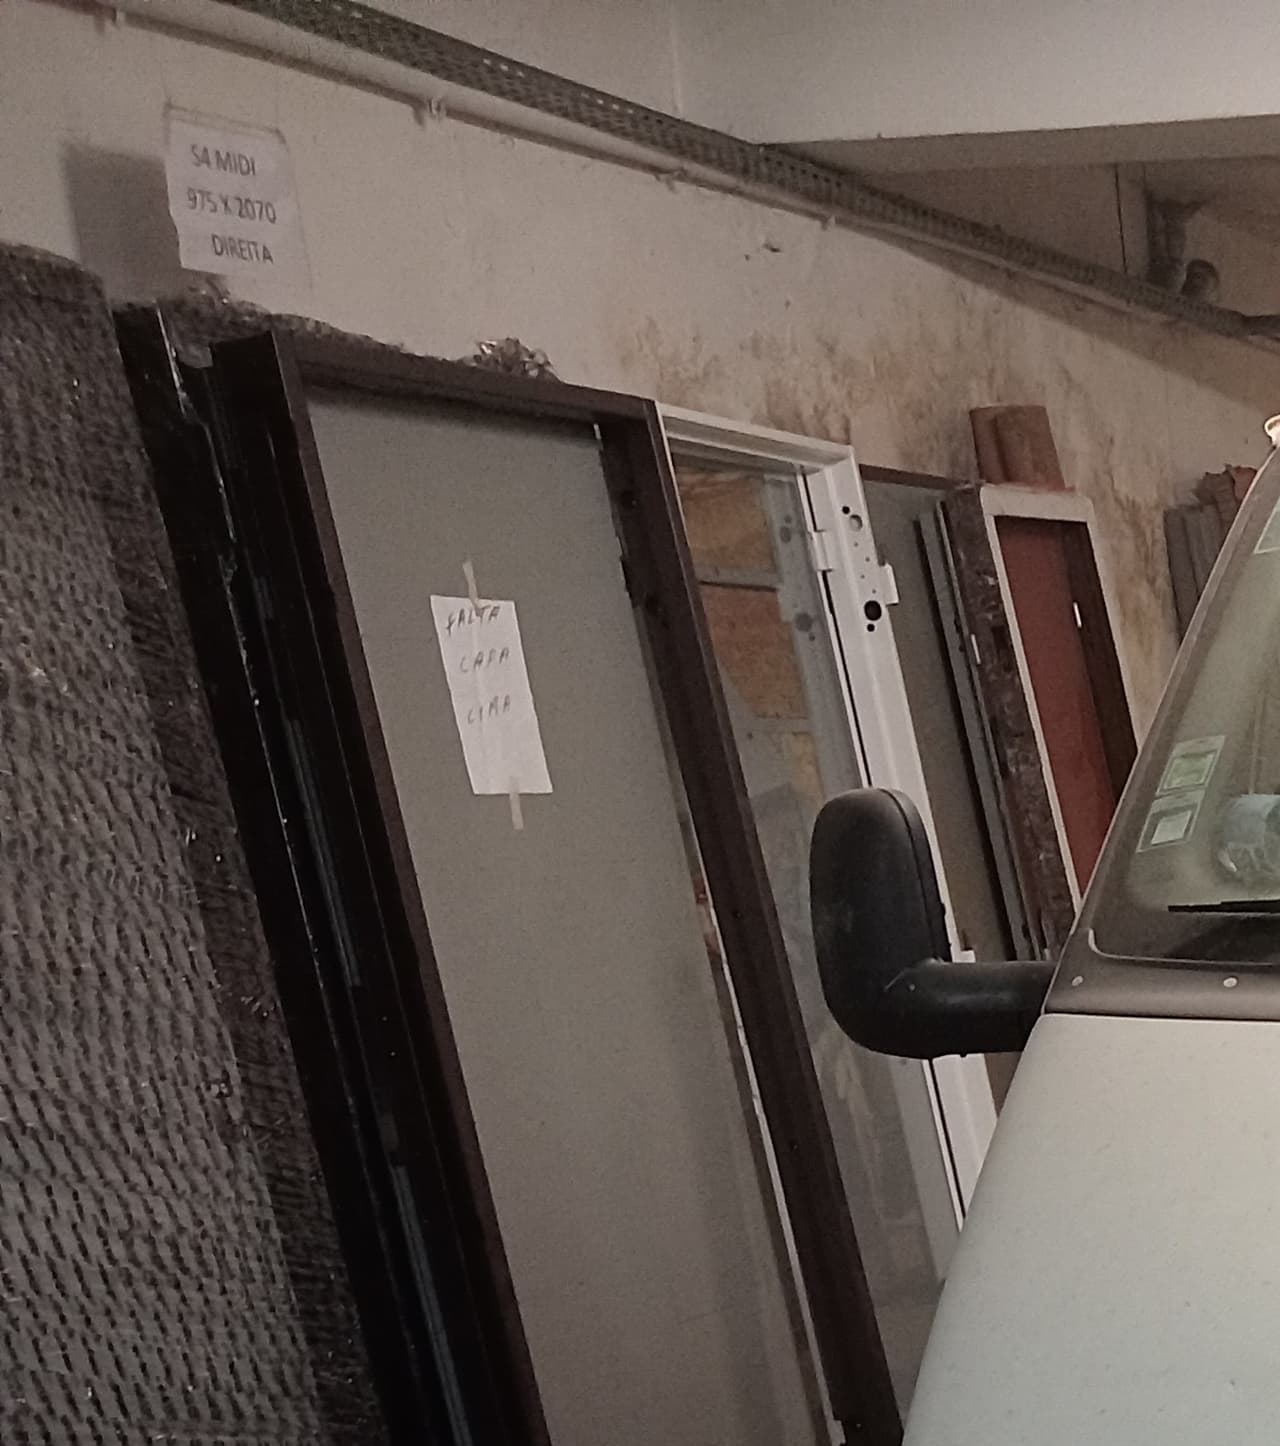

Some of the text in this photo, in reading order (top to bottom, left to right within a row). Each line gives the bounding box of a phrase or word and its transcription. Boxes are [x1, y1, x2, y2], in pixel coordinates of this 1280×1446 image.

[215, 150, 256, 176] MIDI
[187, 187, 218, 214] 975
[233, 196, 277, 225] 2070
[211, 233, 274, 264] DIREITA
